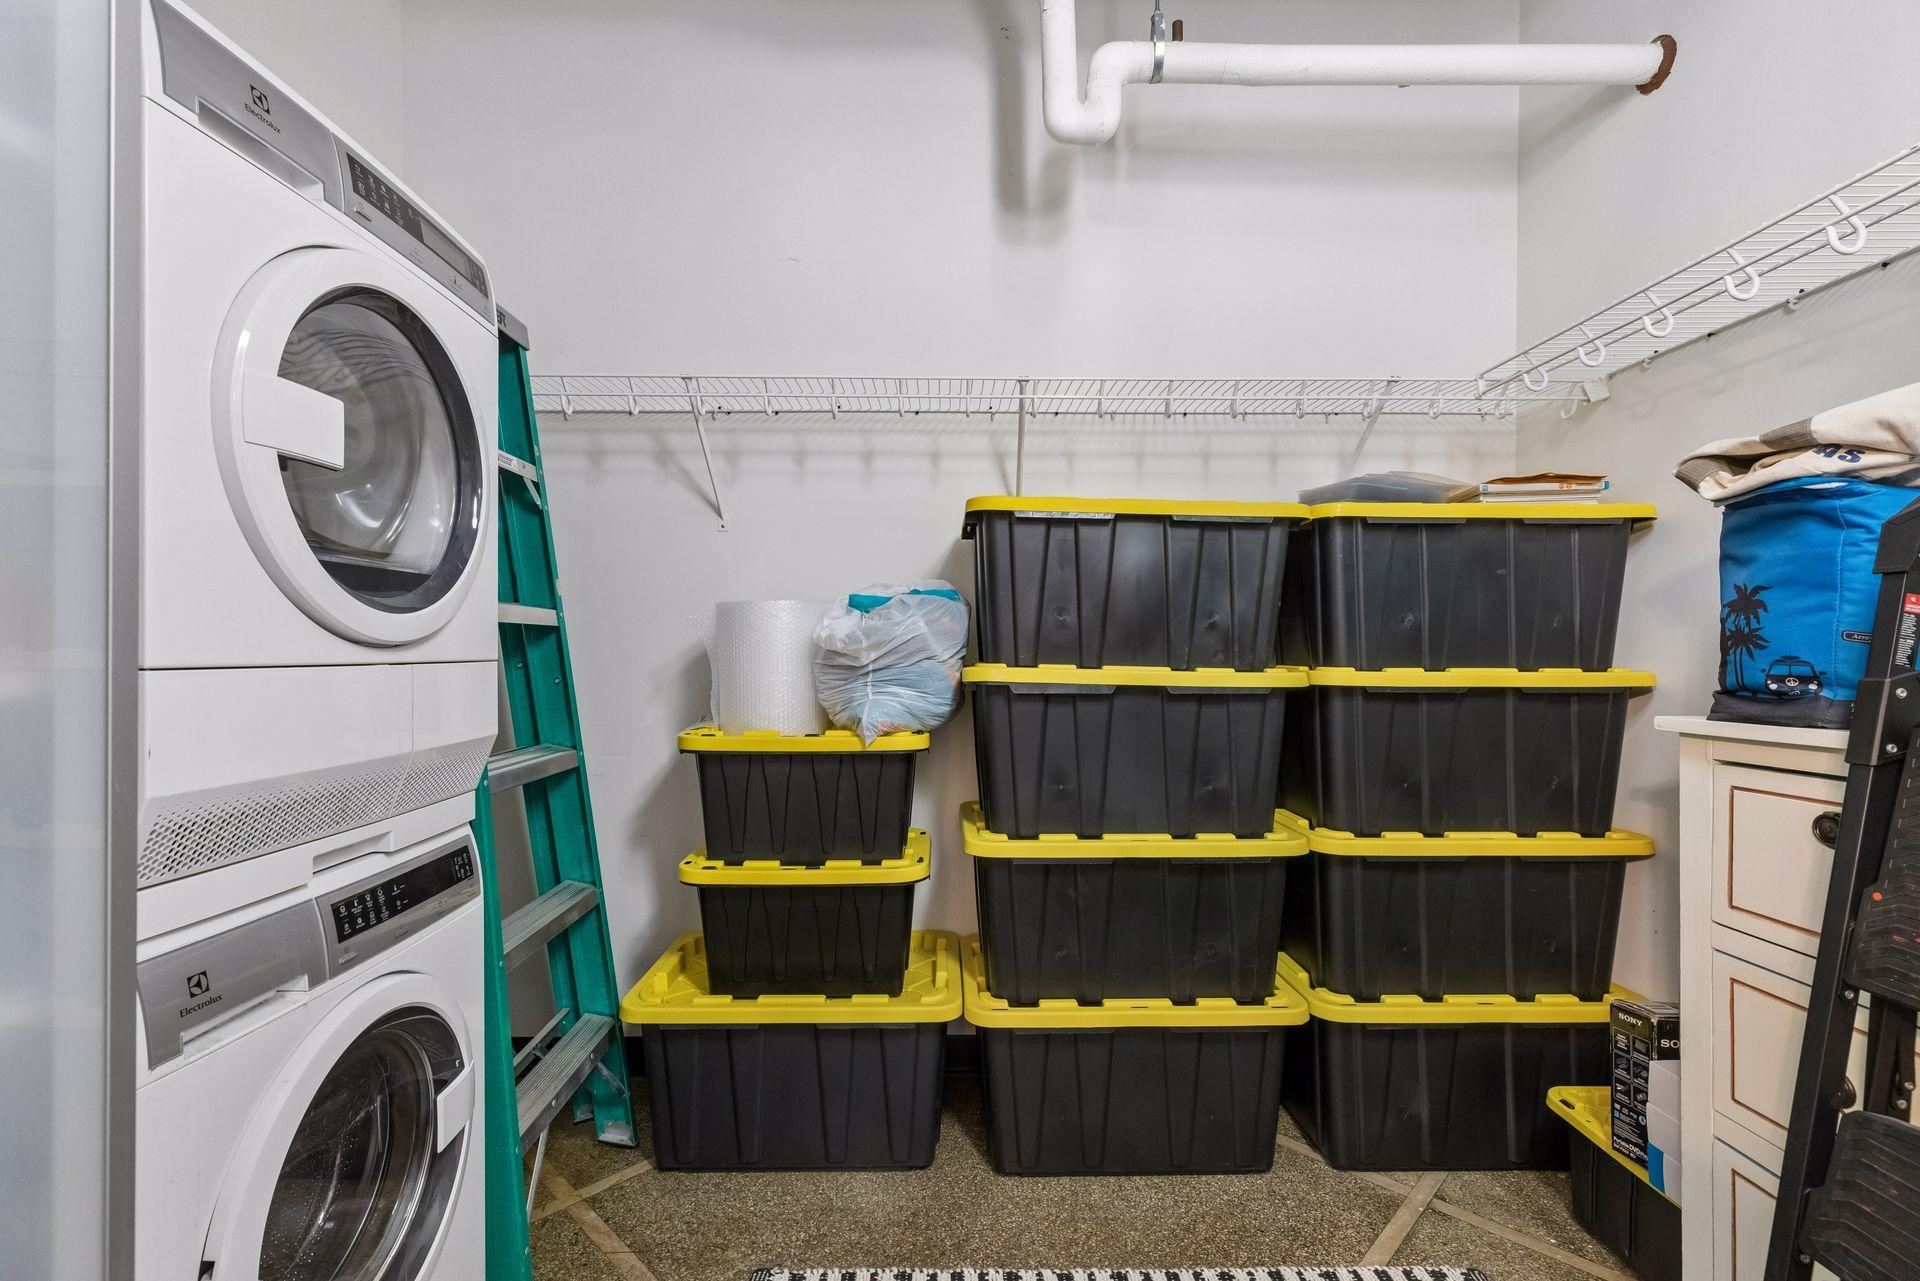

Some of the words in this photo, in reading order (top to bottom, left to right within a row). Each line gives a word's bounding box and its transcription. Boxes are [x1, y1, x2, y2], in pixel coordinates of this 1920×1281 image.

[244, 103, 281, 135] Electrolux
[179, 994, 223, 1018] Electrolux
[1618, 1012, 1643, 1027] SONY
[1660, 1039, 1680, 1049] SO
